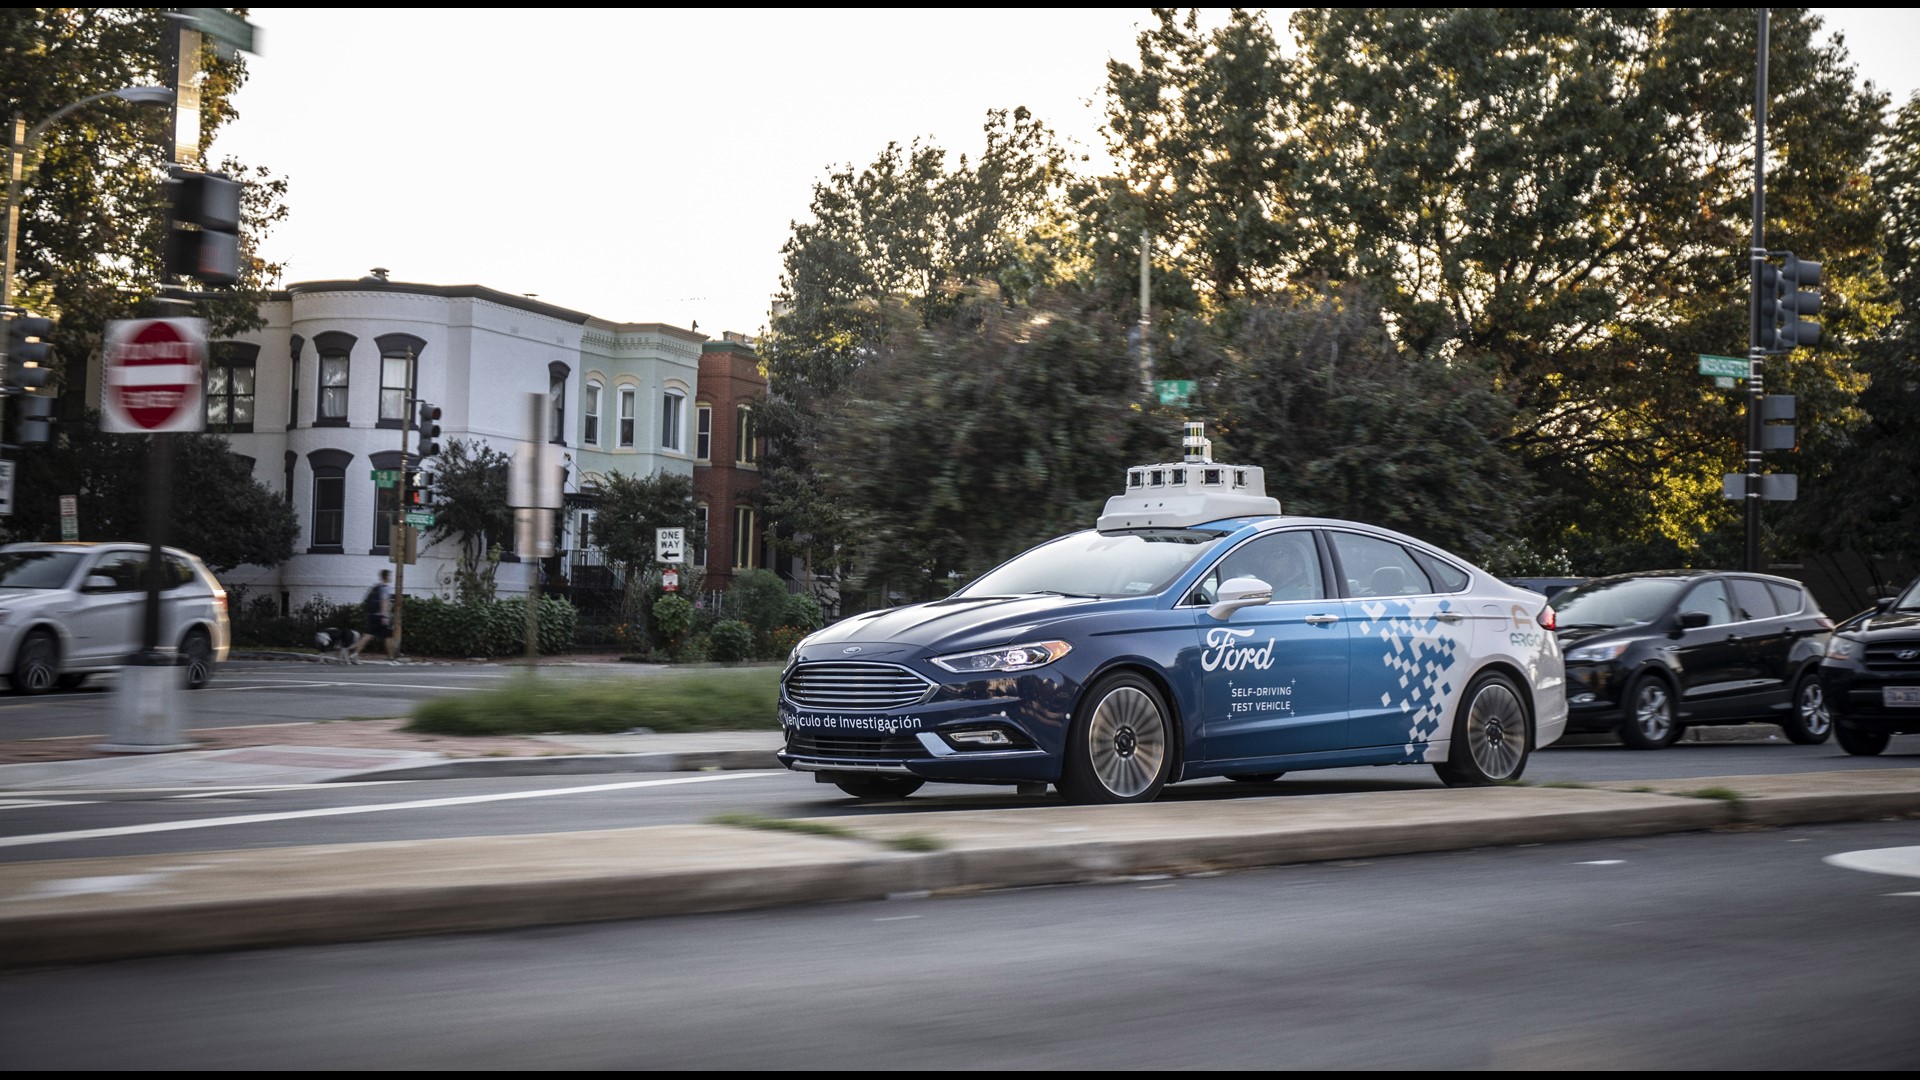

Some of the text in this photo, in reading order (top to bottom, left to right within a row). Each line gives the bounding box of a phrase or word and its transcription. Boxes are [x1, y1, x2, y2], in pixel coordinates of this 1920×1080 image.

[661, 531, 679, 539] ONE
[1510, 632, 1542, 647] ARGO
[1201, 627, 1275, 672] Ford
[1231, 686, 1292, 697] SELF-DRIVING
[1231, 701, 1291, 712] TEST VEHICLE
[823, 715, 837, 728] de
[839, 715, 922, 731] Investigación
